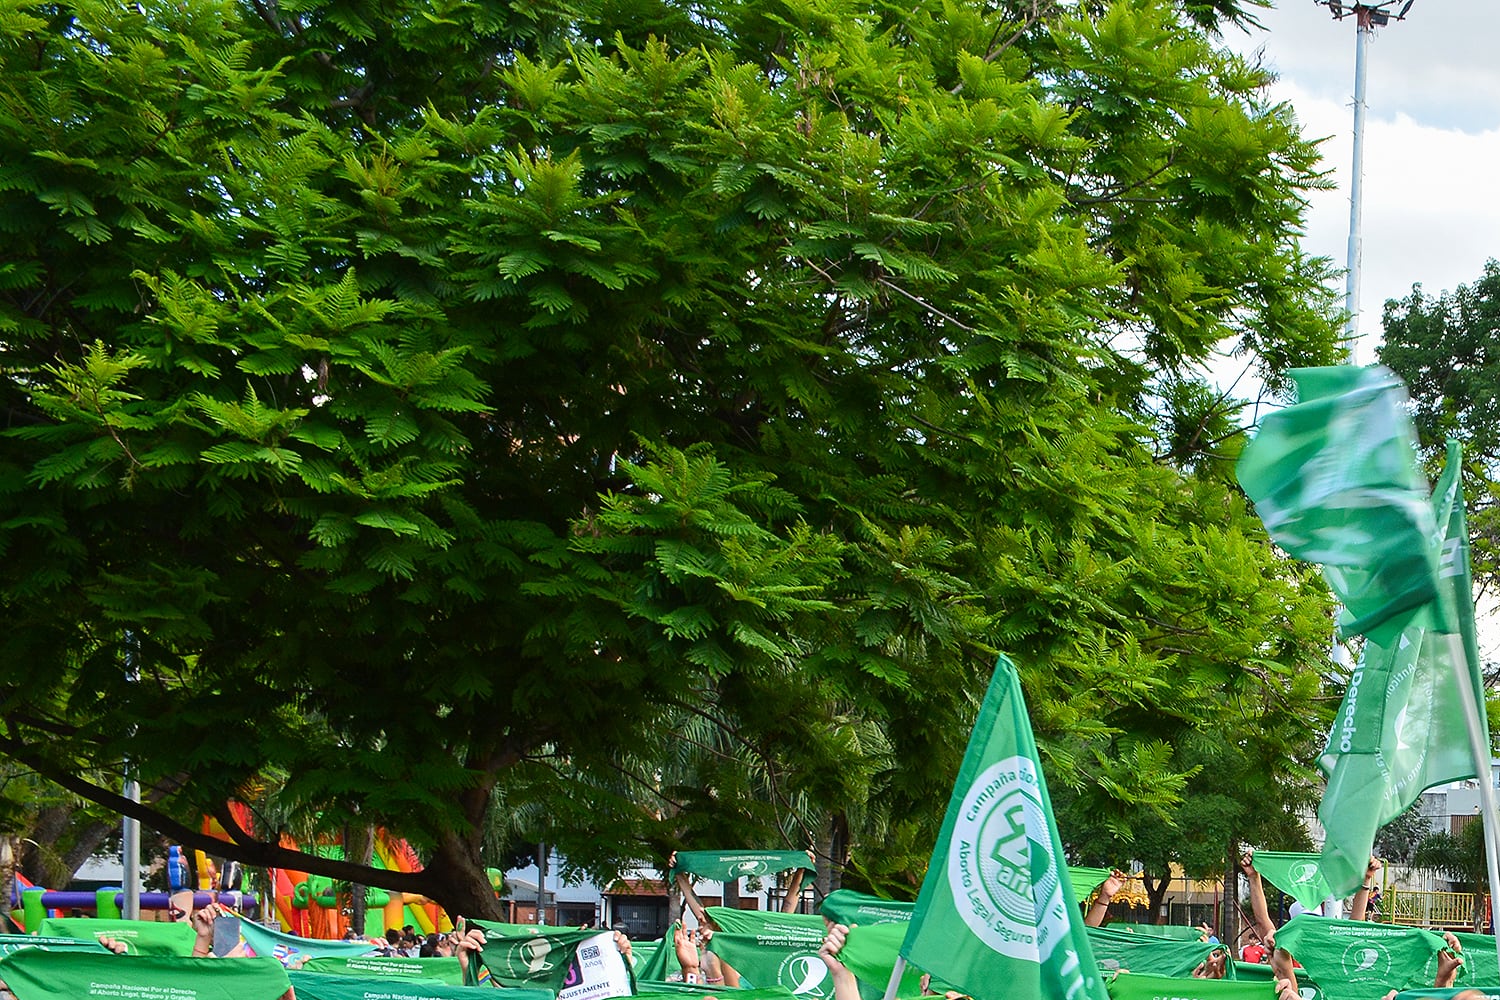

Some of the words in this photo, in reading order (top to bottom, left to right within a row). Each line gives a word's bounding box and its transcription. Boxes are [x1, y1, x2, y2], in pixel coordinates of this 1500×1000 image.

[1340, 672, 1365, 753] Derecho
[960, 840, 971, 888] Aborto
[967, 889, 993, 928] Legal,
[994, 921, 1034, 942] Seguro
[91, 982, 121, 991] Campaña
